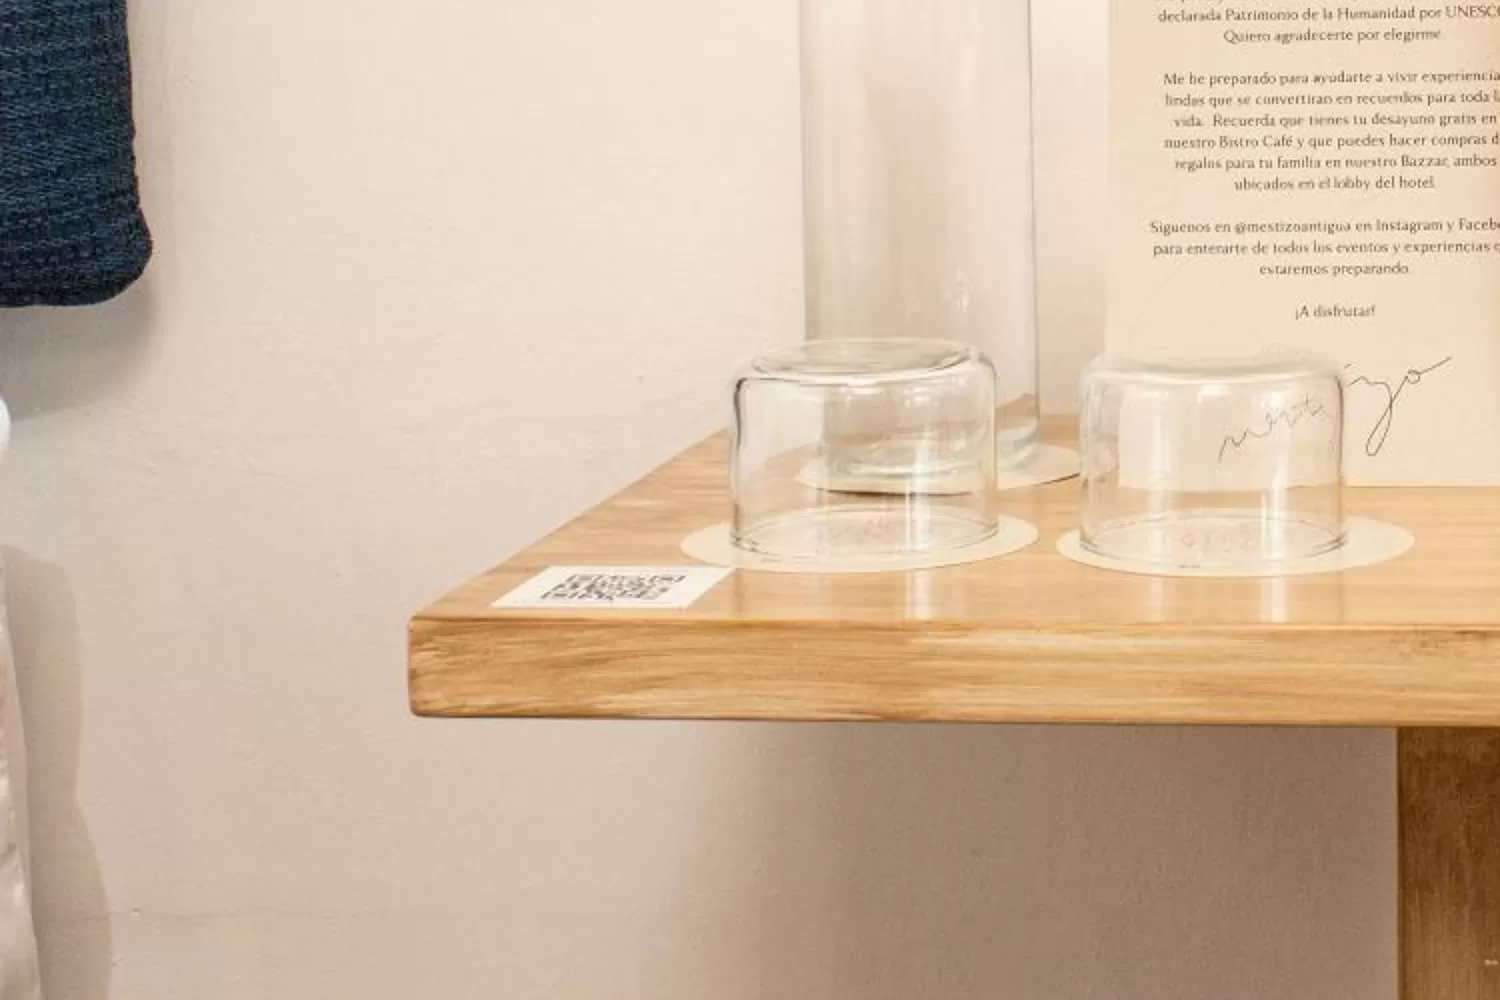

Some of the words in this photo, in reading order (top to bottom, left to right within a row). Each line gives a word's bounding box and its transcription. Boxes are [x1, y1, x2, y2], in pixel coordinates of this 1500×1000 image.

[1157, 9, 1222, 23] declarada
[1300, 7, 1319, 21] de
[1322, 7, 1334, 21] la
[1337, 6, 1416, 20] Humanidad
[1418, 9, 1443, 23] por
[1223, 29, 1271, 46] Quiero
[1273, 28, 1354, 46] agradecerte
[1357, 31, 1381, 45] por
[1163, 72, 1185, 86] Me
[1189, 72, 1205, 86] he
[1209, 71, 1277, 89] preparado
[1279, 74, 1309, 88] para
[1313, 70, 1373, 88] ayudarte
[1375, 74, 1383, 84] a
[1387, 70, 1419, 84] vivir
[1165, 93, 1206, 107] lindas
[1207, 96, 1234, 110] que
[1237, 96, 1251, 106] se
[1335, 95, 1353, 105] en
[1356, 91, 1423, 105] recuerdos
[1426, 94, 1457, 108] para
[1460, 90, 1491, 104] toda
[1212, 113, 1277, 127] Recuerda
[1279, 116, 1305, 130] que
[1309, 113, 1350, 127] tienes
[1353, 112, 1368, 126] tu
[1371, 112, 1436, 129] desayuno
[1439, 111, 1477, 129] gratis
[1480, 115, 1497, 125] en
[1164, 135, 1217, 149] nuestro
[1219, 134, 1260, 148] Bistro
[1261, 134, 1293, 148] Café
[1296, 137, 1305, 151] y
[1307, 137, 1333, 151] que
[1337, 133, 1385, 151] puedes
[1388, 133, 1426, 147] hacer
[1430, 136, 1488, 150] compras
[1175, 156, 1222, 173] regalos
[1225, 159, 1256, 173] para
[1258, 155, 1273, 169] tu
[1277, 155, 1321, 169] familia
[1324, 158, 1341, 169] en
[1344, 154, 1397, 168] nuestro
[1453, 153, 1498, 167] ambos
[1233, 177, 1294, 191] ubicados
[1297, 180, 1315, 190] en
[1318, 176, 1331, 190] el
[1333, 176, 1371, 193] lobby
[1375, 176, 1395, 190] del
[1214, 223, 1231, 233] en
[1234, 219, 1351, 236] @mestizoantigua
[1355, 222, 1373, 232] en
[1376, 218, 1443, 235] Instagram
[1446, 221, 1455, 235] y
[1153, 244, 1183, 258] para
[1186, 241, 1249, 255] enterarte
[1251, 240, 1269, 254] de
[1273, 240, 1309, 254] todos
[1313, 240, 1333, 254] los
[1335, 240, 1389, 254] eventos
[1393, 243, 1401, 257] y
[1403, 239, 1491, 257] experiencias
[1259, 261, 1329, 275] estaremos
